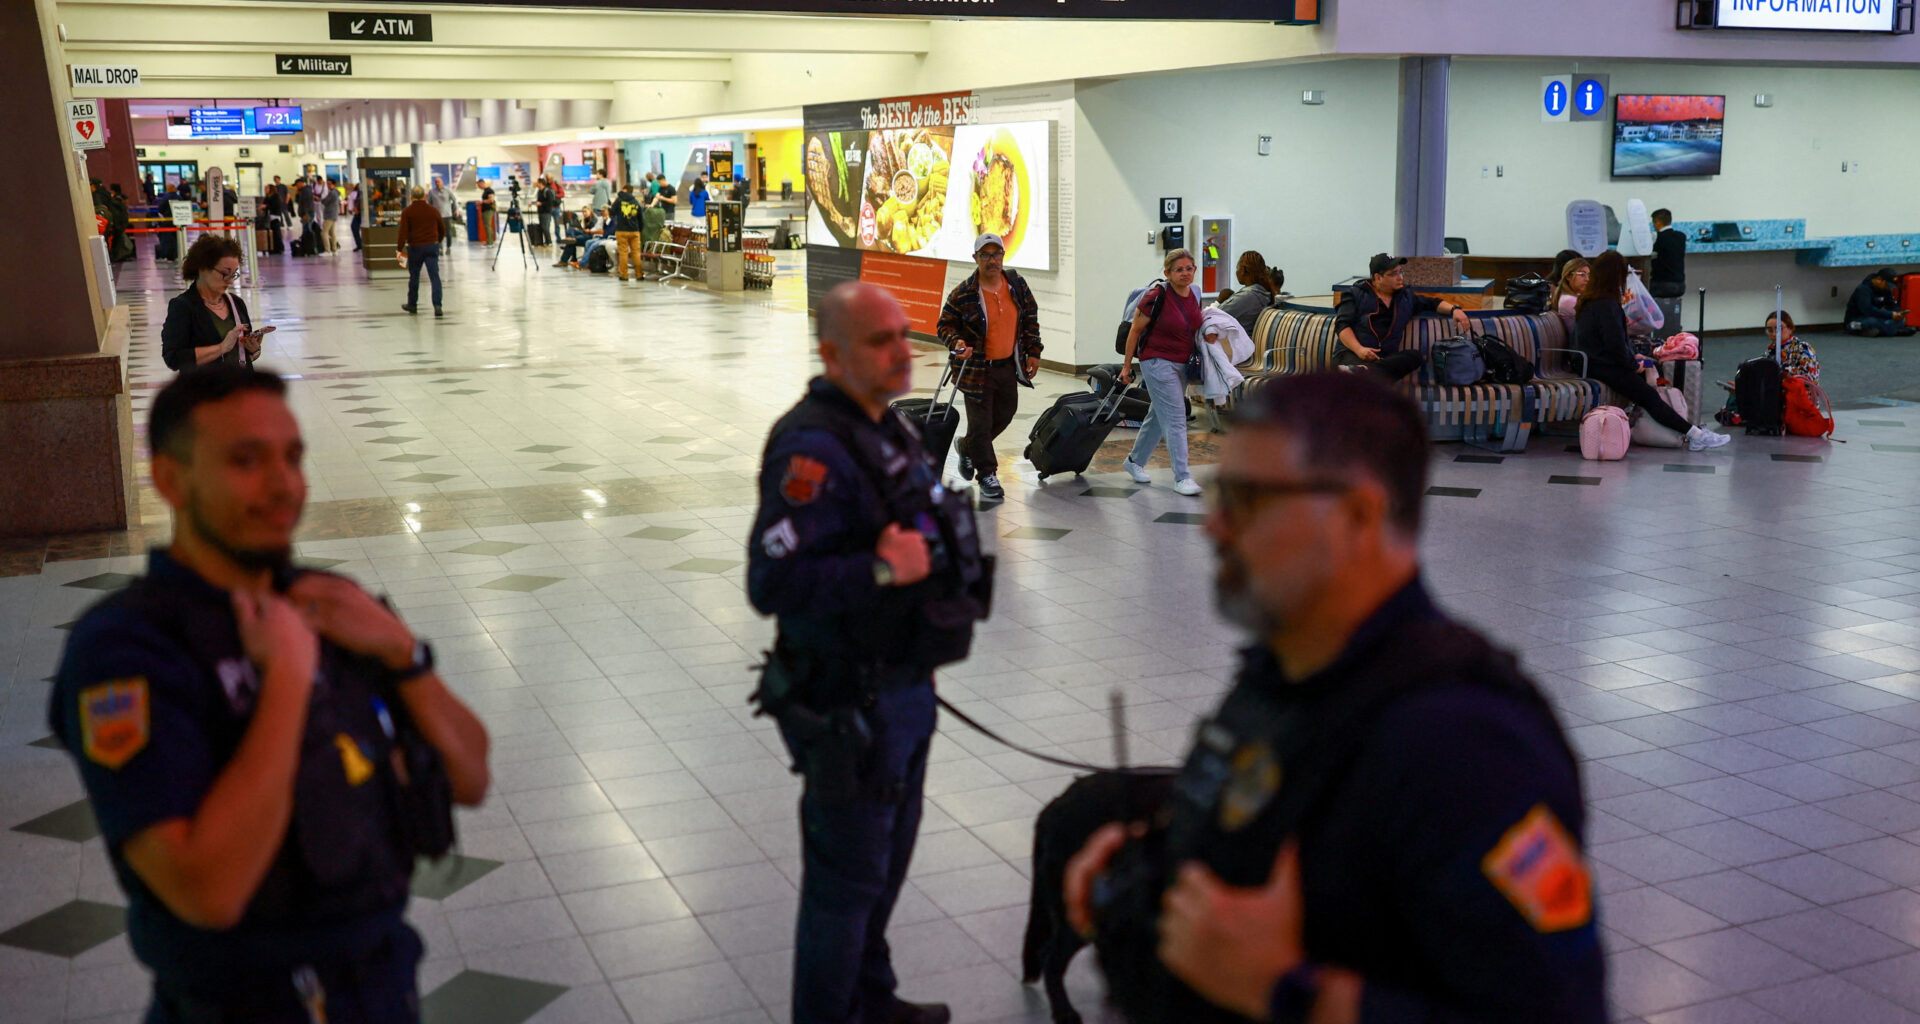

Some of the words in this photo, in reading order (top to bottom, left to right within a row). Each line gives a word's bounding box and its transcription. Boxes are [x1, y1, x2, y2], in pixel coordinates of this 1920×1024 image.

[372, 19, 414, 35] ATM
[298, 59, 348, 73] Military
[74, 68, 103, 84] MAIL
[106, 68, 138, 84] DROP
[72, 104, 93, 116] AED
[861, 106, 878, 129] The
[878, 101, 911, 129] BEST
[911, 103, 924, 128] of
[923, 105, 941, 126] the
[942, 95, 980, 125] BEST
[265, 113, 290, 124] 7:21
[553, 155, 560, 164] 3
[696, 152, 703, 163] 2
